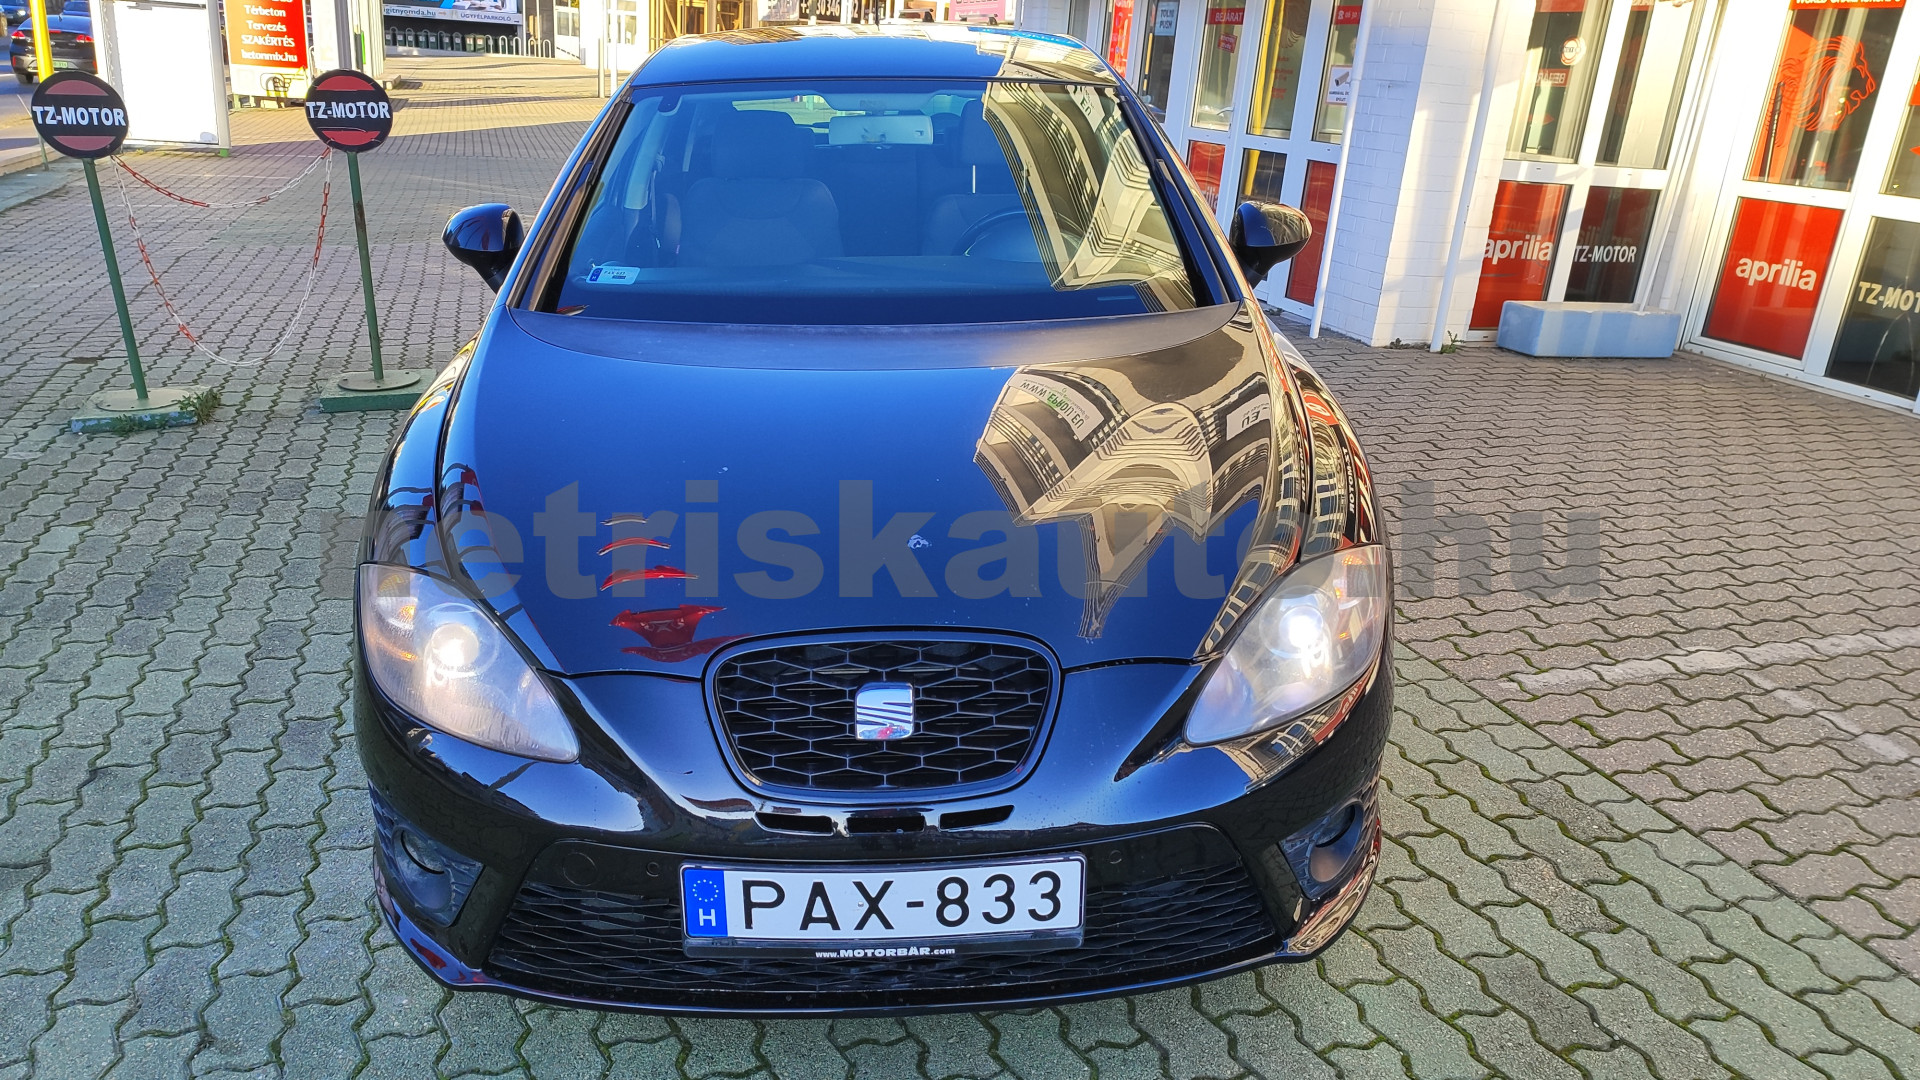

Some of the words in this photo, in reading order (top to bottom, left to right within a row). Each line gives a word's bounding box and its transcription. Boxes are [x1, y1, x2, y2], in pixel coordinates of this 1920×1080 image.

[243, 5, 286, 17] Térbeton
[1215, 11, 1243, 22] BEJÁRAT
[246, 20, 287, 32] Tervezés
[241, 33, 295, 47] SZAKÉRTÉS
[32, 105, 127, 127] TZ-MOTOR
[305, 100, 391, 120] TZ-MOTOR
[1483, 234, 1553, 264] aprilia
[1574, 245, 1637, 263] TZ-MOTOR
[1736, 257, 1817, 291] aprilia
[698, 908, 716, 927] H
[741, 869, 1062, 931] PAX-833
[815, 946, 955, 958] www.MOTORBÄR.com
